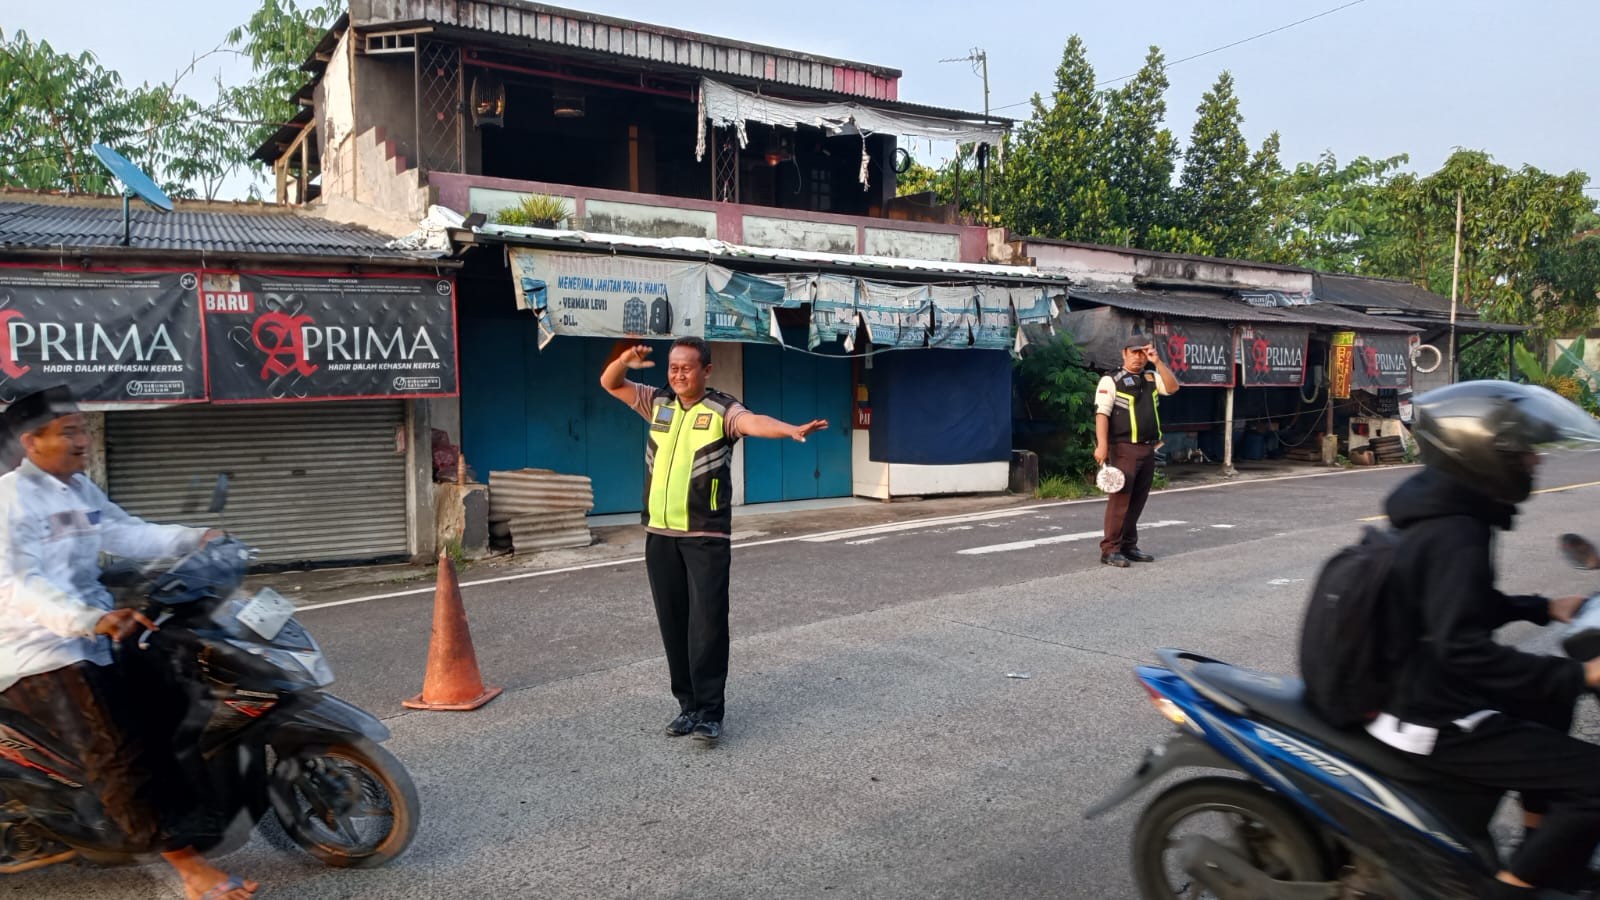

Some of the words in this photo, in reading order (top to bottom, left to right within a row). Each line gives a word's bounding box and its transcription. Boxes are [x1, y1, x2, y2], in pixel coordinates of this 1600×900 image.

[558, 275, 594, 291] MENERIMA
[595, 278, 622, 293] JAHITAN
[622, 281, 637, 294] PRIA
[205, 294, 249, 311] BARU
[563, 297, 590, 310] VERMAK
[1184, 343, 1226, 365] PRIMA
[1266, 347, 1303, 366] PRIMA
[43, 364, 73, 373] HADIR
[74, 364, 106, 373] DALAM
[108, 364, 149, 373] KEMASAN
[150, 364, 184, 373] KERTAS
[328, 363, 350, 371] HADIR
[352, 363, 377, 371] DALAM
